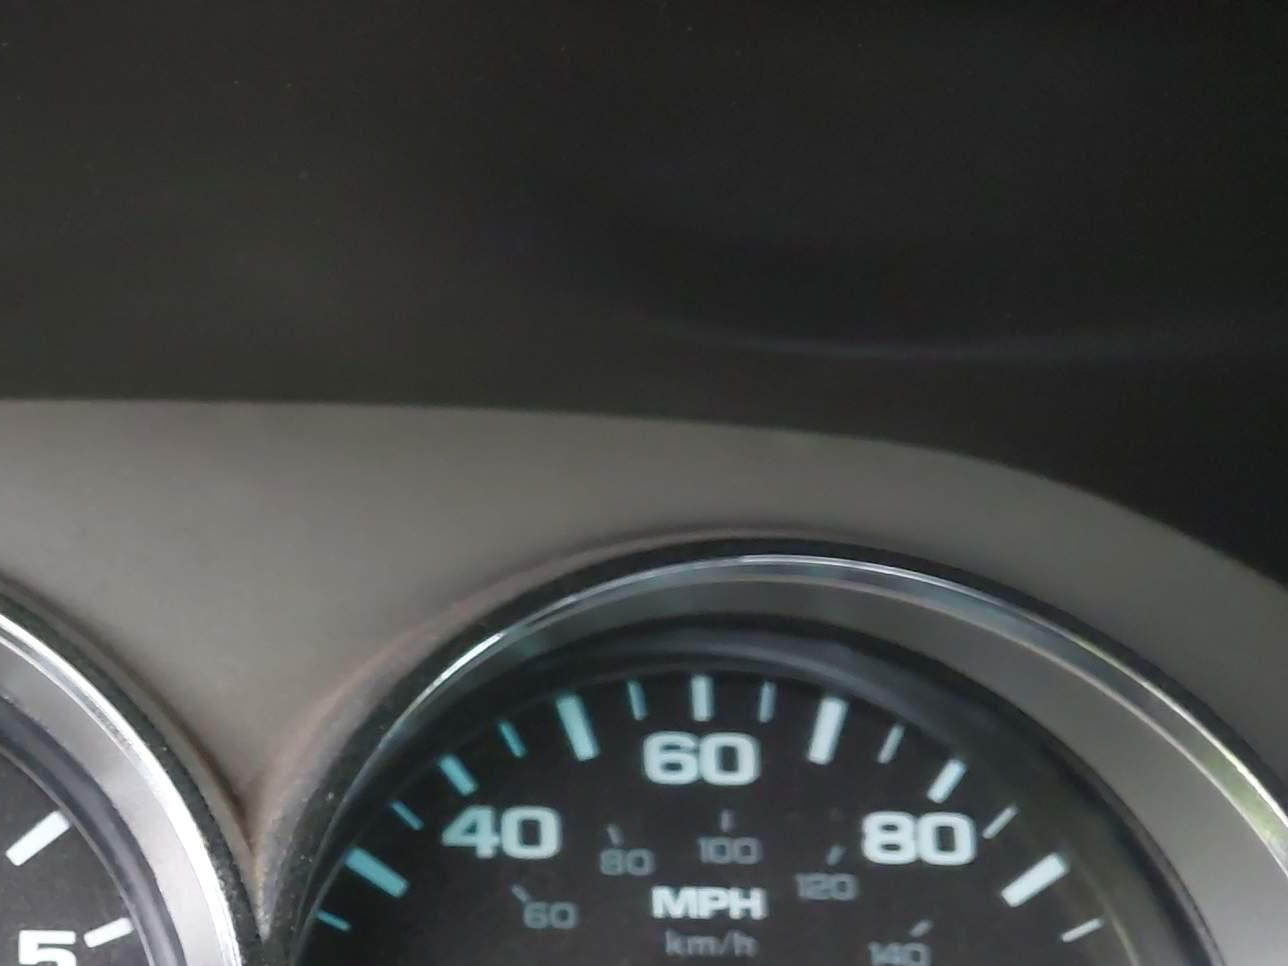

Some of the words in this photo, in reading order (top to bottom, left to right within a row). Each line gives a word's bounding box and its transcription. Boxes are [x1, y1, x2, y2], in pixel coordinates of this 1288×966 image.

[644, 732, 759, 785] 60
[442, 806, 561, 857] 40
[863, 812, 975, 864] 80
[600, 849, 653, 875] 80
[699, 838, 760, 864] 100
[796, 874, 857, 900] 120
[525, 903, 577, 929] 60
[652, 888, 766, 919] MPH
[665, 930, 758, 957] km/h
